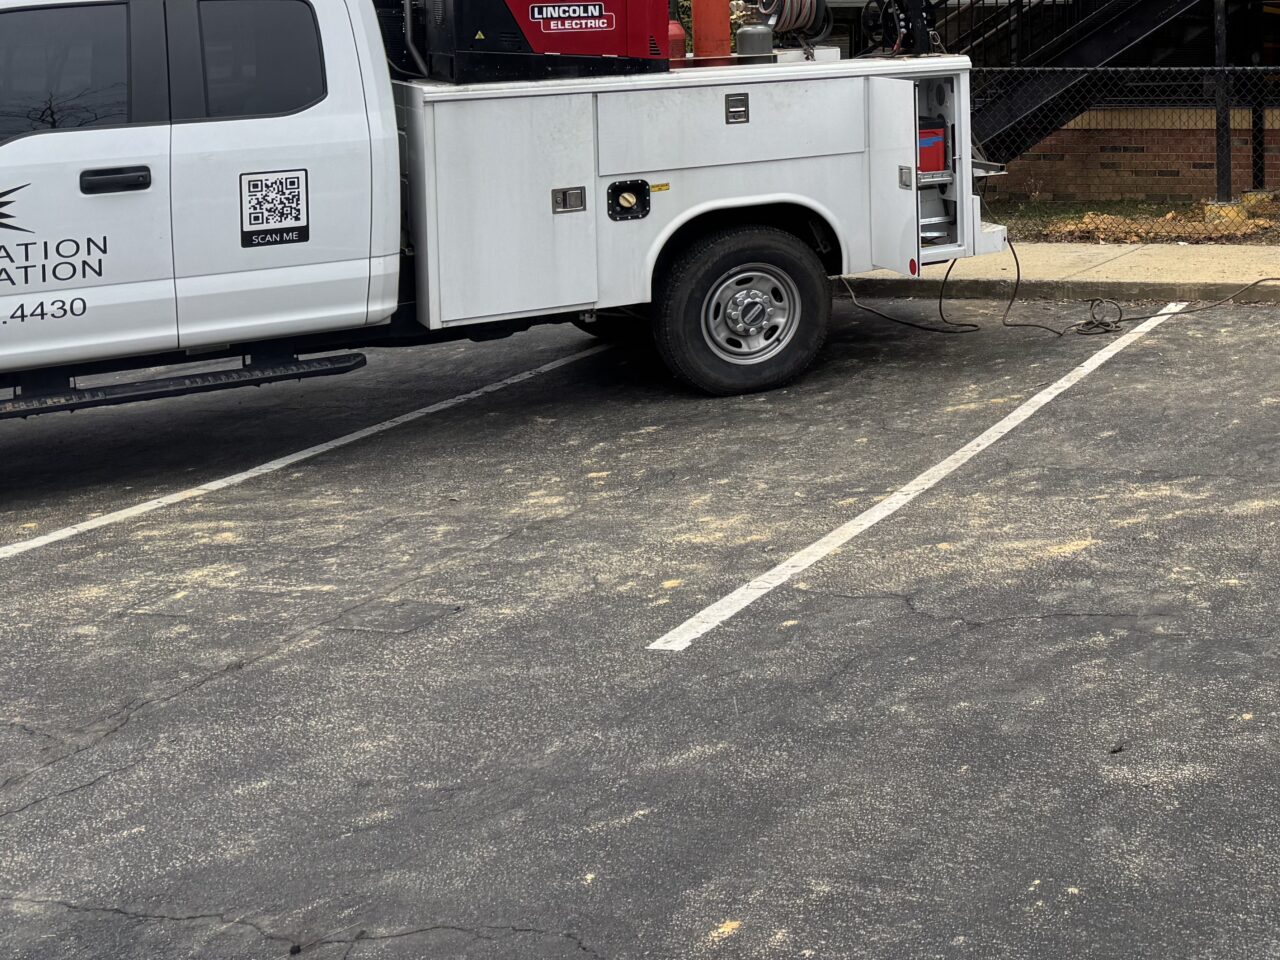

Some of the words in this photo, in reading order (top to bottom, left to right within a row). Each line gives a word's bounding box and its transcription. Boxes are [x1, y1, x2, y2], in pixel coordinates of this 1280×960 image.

[534, 5, 600, 19] LINCOLN
[550, 19, 608, 30] ELECTRIC
[252, 233, 280, 244] SCAN
[283, 231, 299, 241] ME
